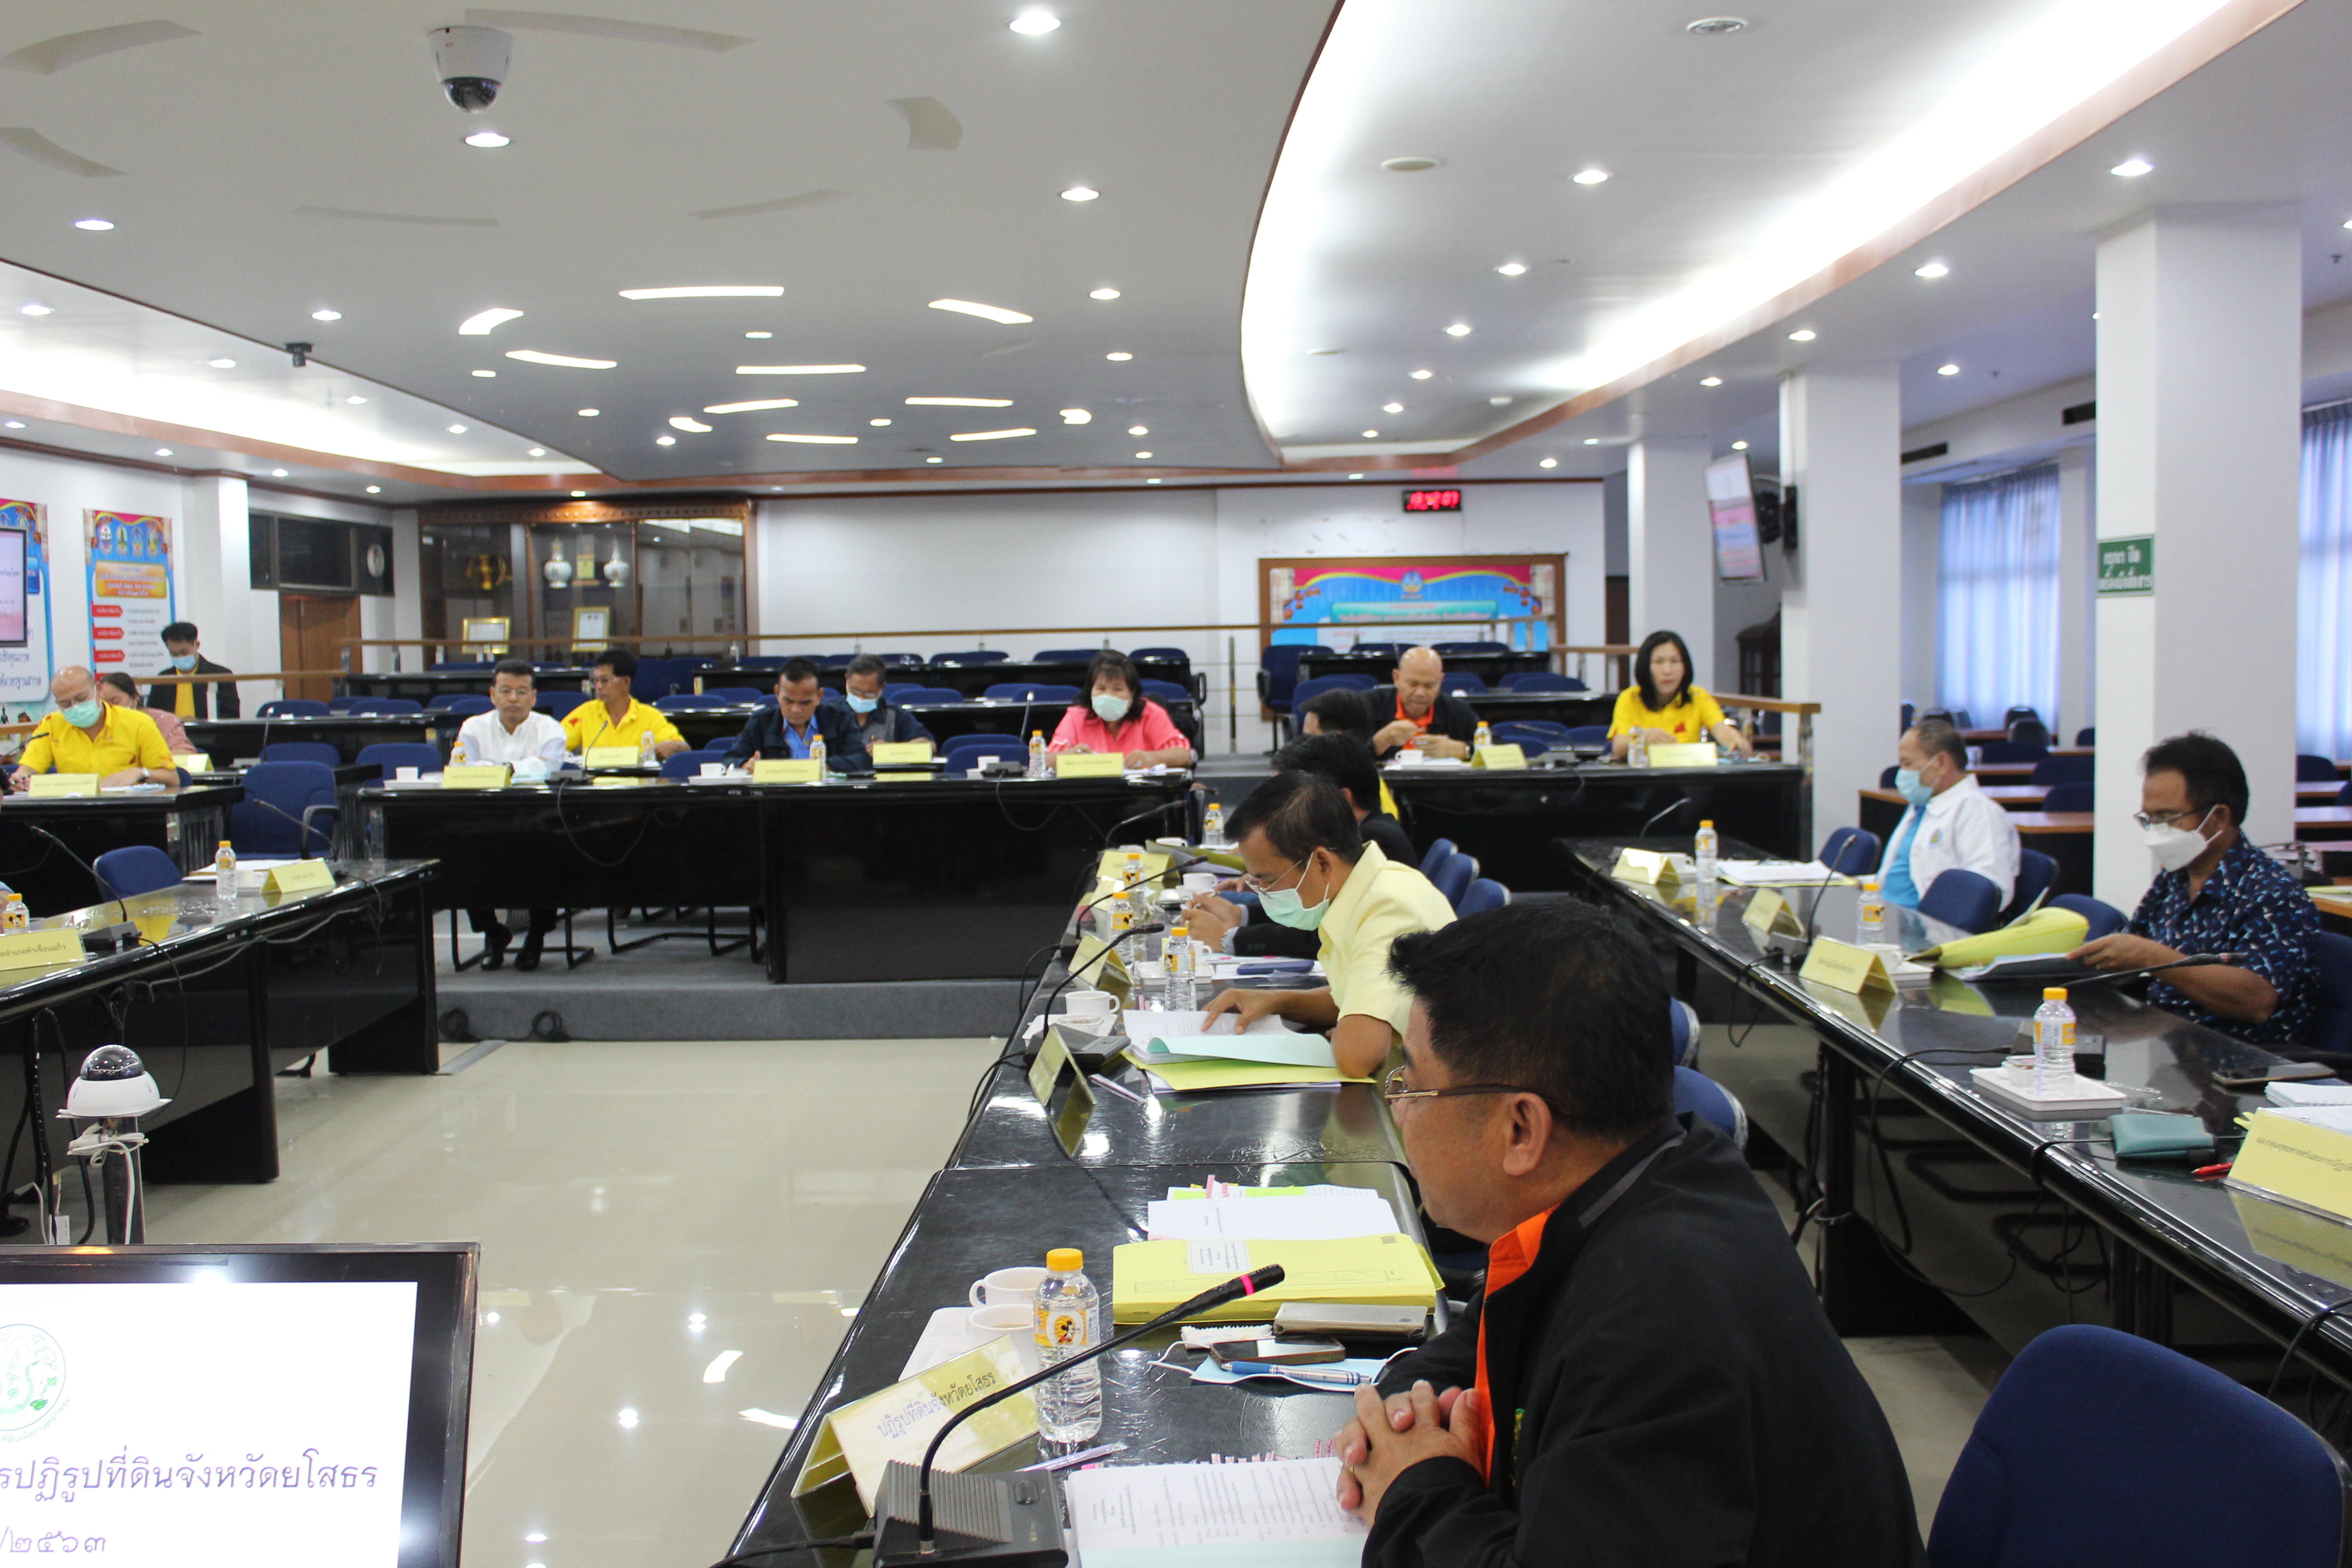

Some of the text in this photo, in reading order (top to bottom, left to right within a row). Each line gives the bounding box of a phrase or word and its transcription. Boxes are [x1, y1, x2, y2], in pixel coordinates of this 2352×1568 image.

[0, 943, 66, 957] ยอำเภอคำเขื่อนแก้ว
[877, 1372, 996, 1439] ปฏิรูปที่ดินจังหวัดยโสธร
[0, 1445, 378, 1503] รปฏิรูปที่ดินจังหวัดยโสธร
